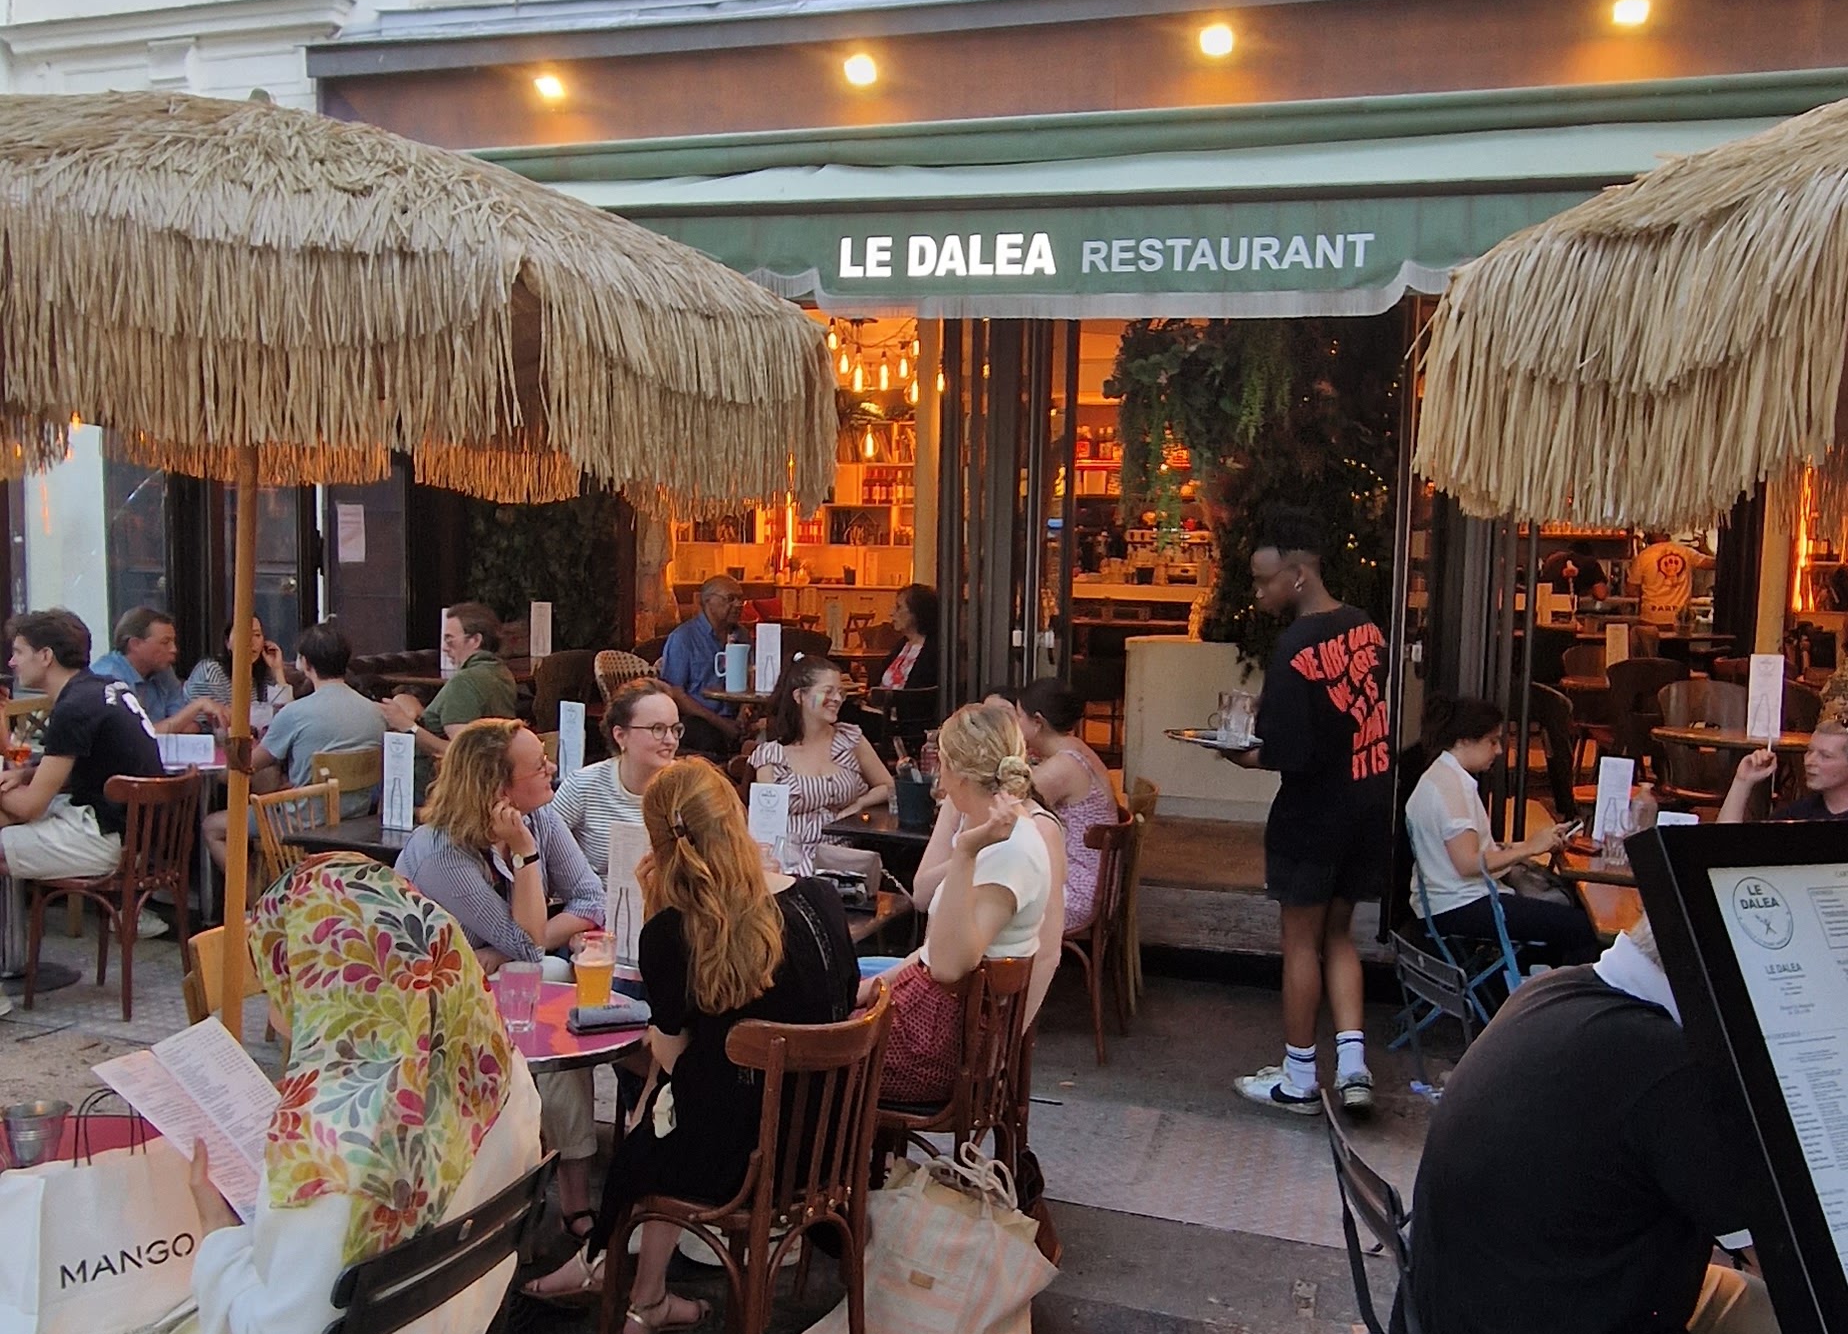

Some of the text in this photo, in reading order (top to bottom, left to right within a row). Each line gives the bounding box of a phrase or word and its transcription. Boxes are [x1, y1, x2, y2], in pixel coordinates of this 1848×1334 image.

[838, 232, 1375, 278] LE DALEA RESTAURANT
[1290, 647, 1325, 681] WE
[1318, 634, 1349, 680] ARE
[1352, 741, 1390, 781] IT IS
[1740, 898, 1779, 909] DALEA
[1747, 885, 1762, 896] LE
[60, 1232, 195, 1290] MANGO
